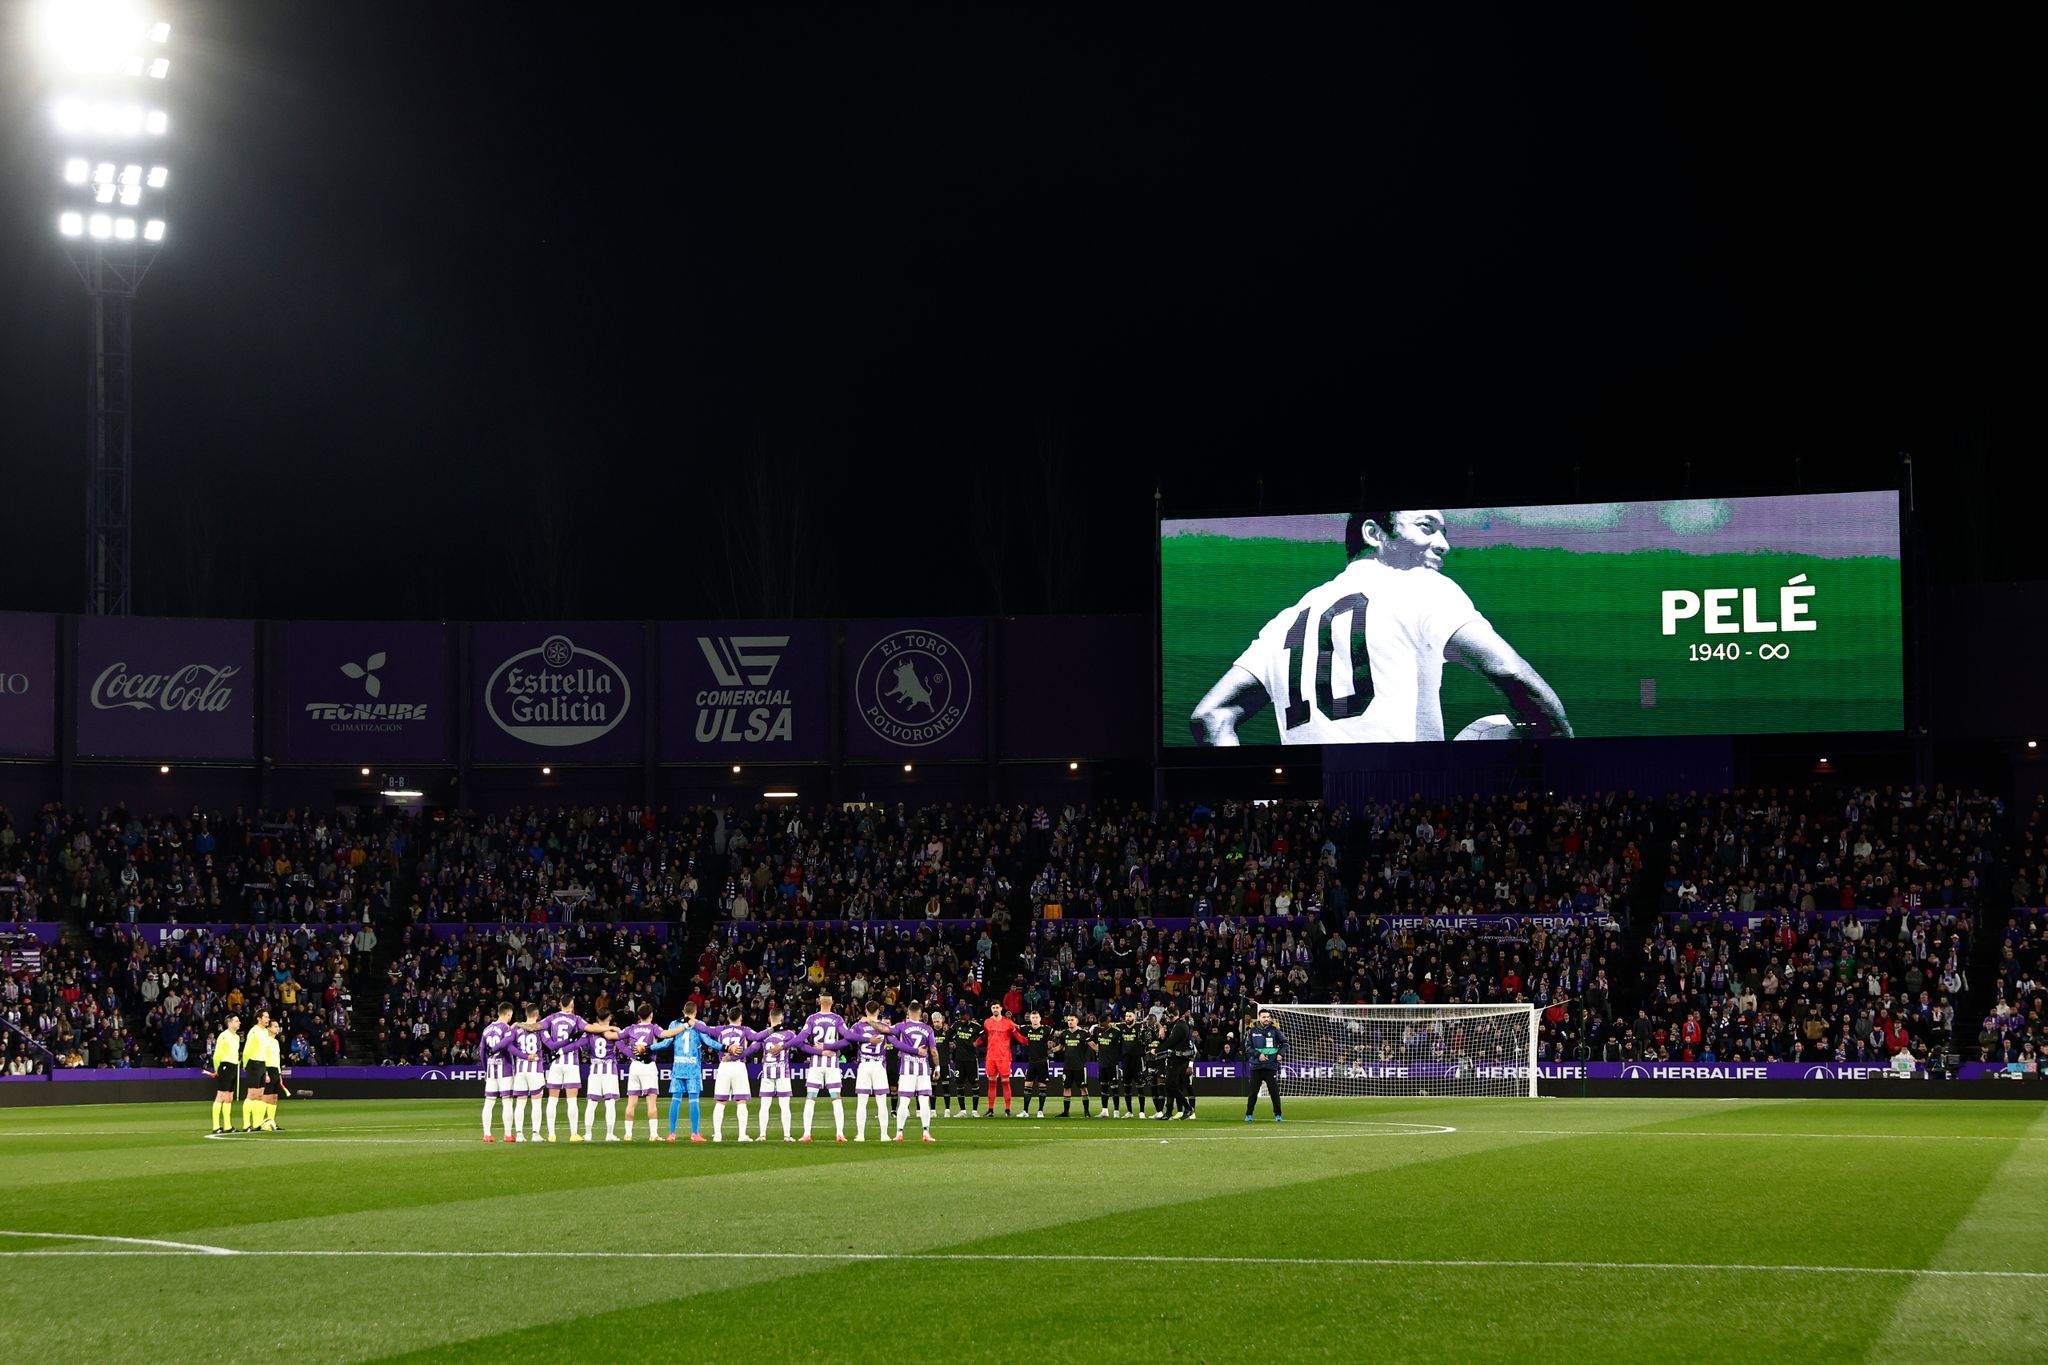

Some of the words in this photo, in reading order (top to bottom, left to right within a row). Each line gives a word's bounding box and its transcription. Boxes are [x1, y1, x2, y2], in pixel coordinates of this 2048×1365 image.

[1662, 573, 1817, 635] PELÉ
[880, 639, 902, 657] EL
[905, 634, 948, 656] TORO
[1688, 642, 1740, 662] 1940
[1283, 591, 1376, 731] 10
[90, 662, 241, 712] Coca-Cola
[505, 667, 613, 694] Estrella
[511, 694, 607, 722] Galicia
[695, 689, 793, 706] COMERCIAL
[305, 702, 428, 720] TECNAIRE
[695, 707, 793, 743] ULSA
[866, 705, 960, 741] POLVORONES
[557, 1024, 569, 1041] 5
[682, 1031, 690, 1054] 1
[812, 1026, 836, 1046] 24
[861, 1033, 885, 1054] 27
[911, 1034, 923, 1049] 7
[517, 1033, 538, 1055] 18
[595, 1037, 607, 1058] 8
[1653, 1067, 1768, 1079] HERBALIFE
